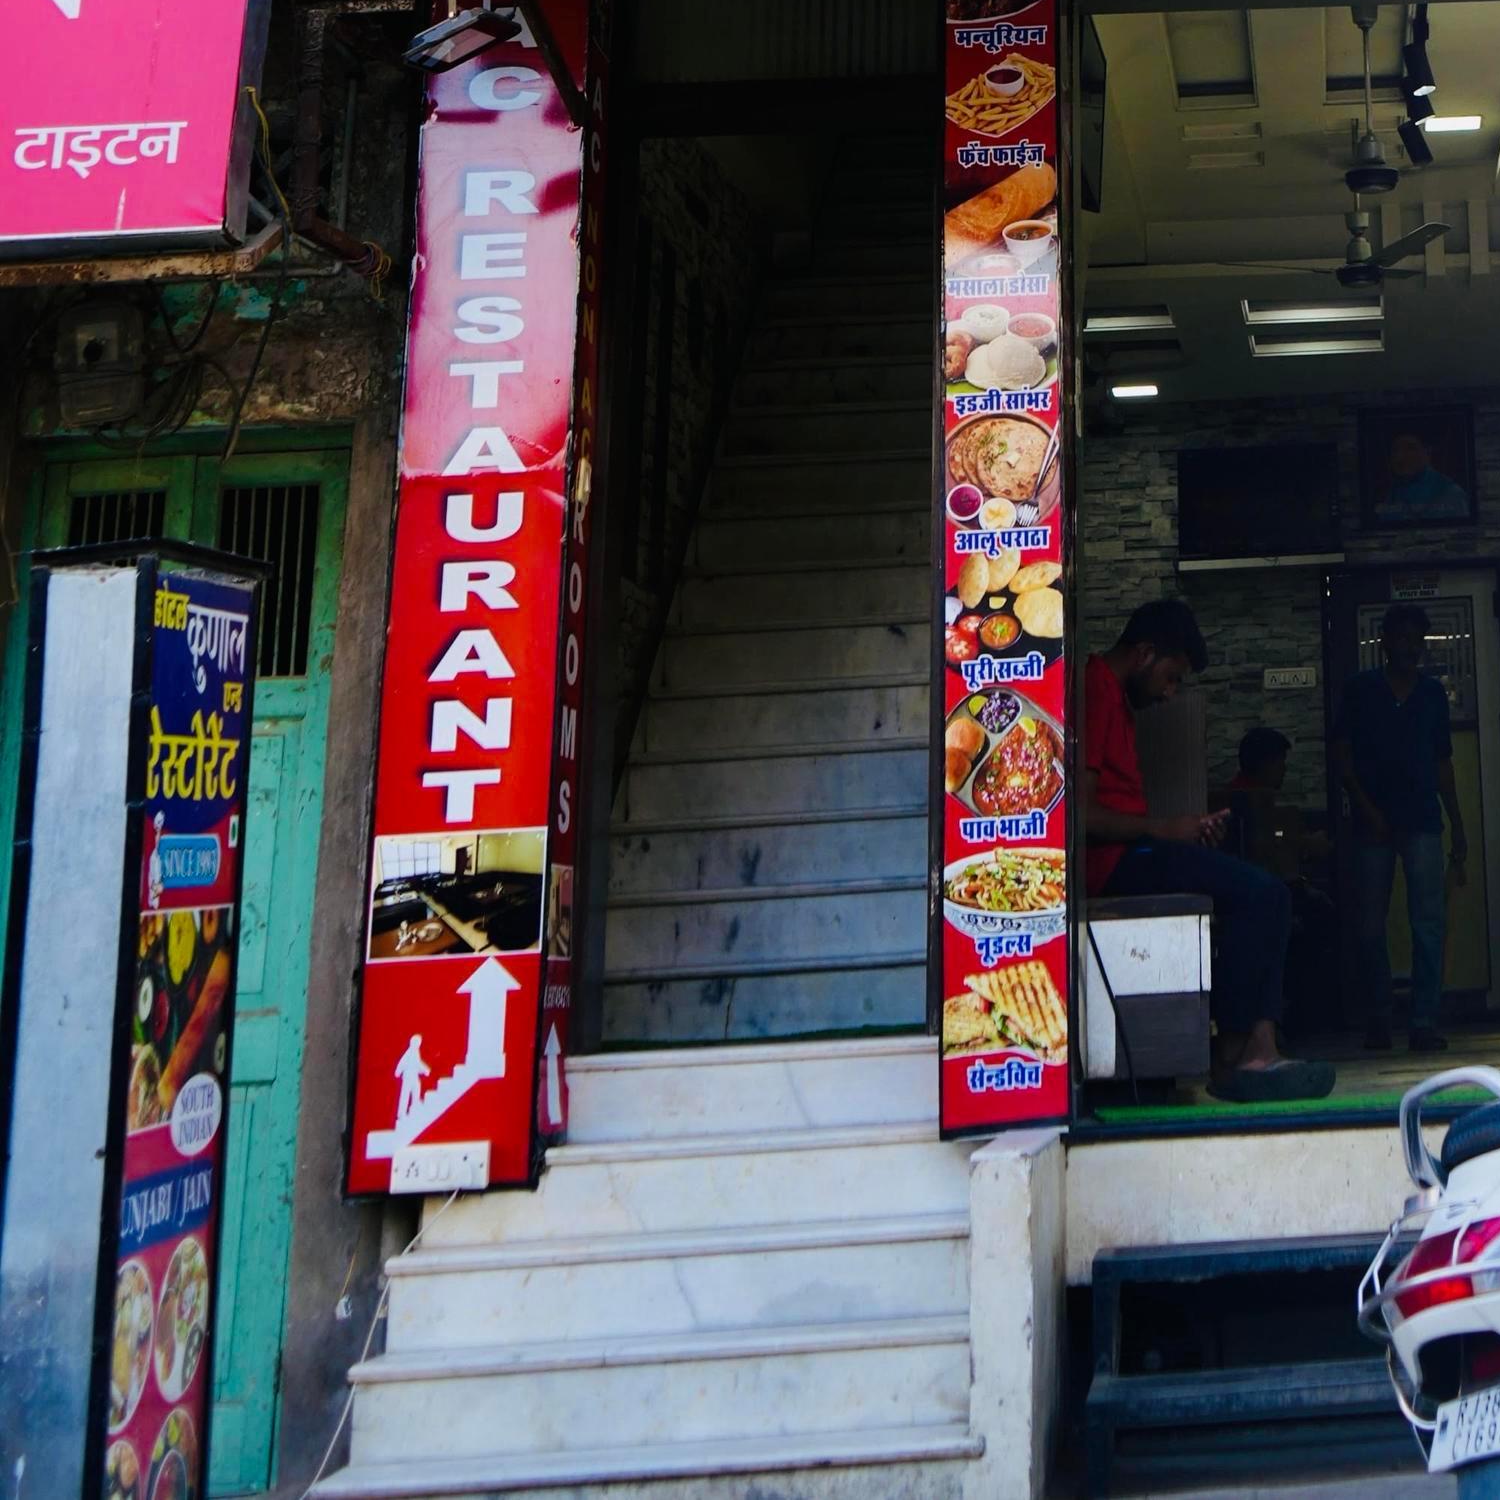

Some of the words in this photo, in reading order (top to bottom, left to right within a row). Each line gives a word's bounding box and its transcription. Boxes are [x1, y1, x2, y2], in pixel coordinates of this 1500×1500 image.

[14, 121, 189, 180] टाइटन
[947, 276, 1007, 297] मसाला
[1008, 268, 1050, 295] डोसा
[1005, 385, 1051, 412] सांभर
[423, 171, 540, 823] RESTAURANT
[956, 529, 999, 555] आलू
[1000, 526, 1051, 549] पराठा
[154, 579, 190, 631] होटल
[187, 603, 248, 694] कुणाल
[962, 652, 995, 691] पूरी
[997, 650, 1046, 683] सब्जी
[146, 704, 240, 801] रेस्टोरेंट
[961, 815, 999, 843] पाव
[999, 811, 1047, 838] भाजी
[975, 934, 1032, 967] नूडल्स
[180, 1083, 215, 1116] SOUTH
[178, 1113, 214, 1148] INDIAN
[178, 1168, 214, 1228] JAIN
